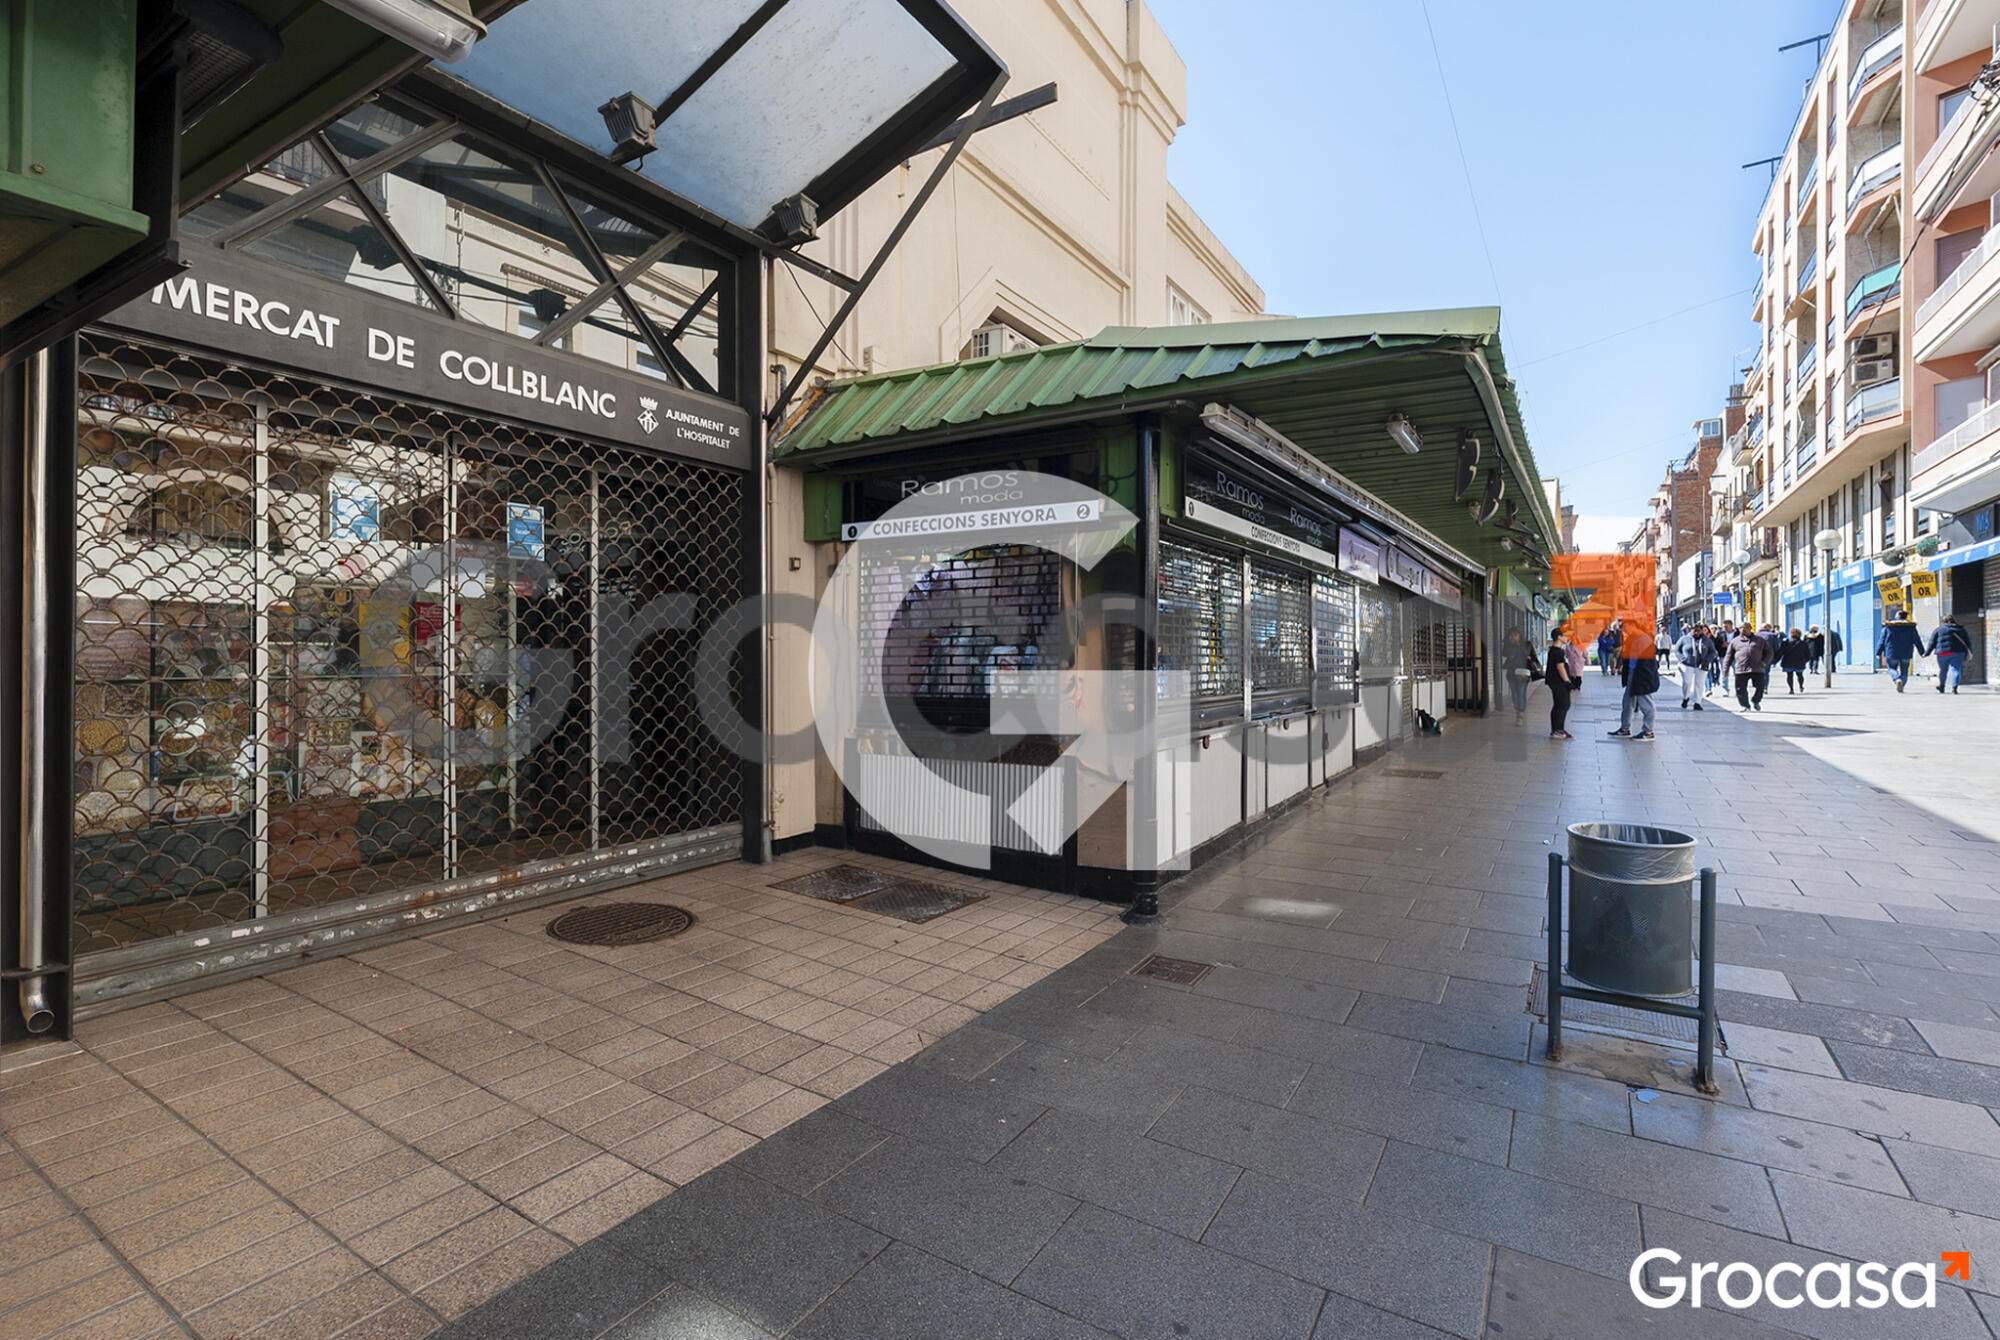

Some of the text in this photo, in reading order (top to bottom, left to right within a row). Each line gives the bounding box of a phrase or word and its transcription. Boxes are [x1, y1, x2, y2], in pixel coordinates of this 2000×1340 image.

[151, 276, 617, 419] MERCAT DE COLLBLANC
[665, 409, 740, 437] AJUNTAMENT DE
[677, 427, 731, 449] L'HOSPITALET
[901, 472, 1019, 499] Ramos
[960, 489, 1024, 505] moda
[1217, 471, 1264, 510] Ramos
[873, 515, 976, 536] CONFECCIONS
[981, 507, 1057, 527] SENYORA
[1290, 507, 1321, 536] Ramos
